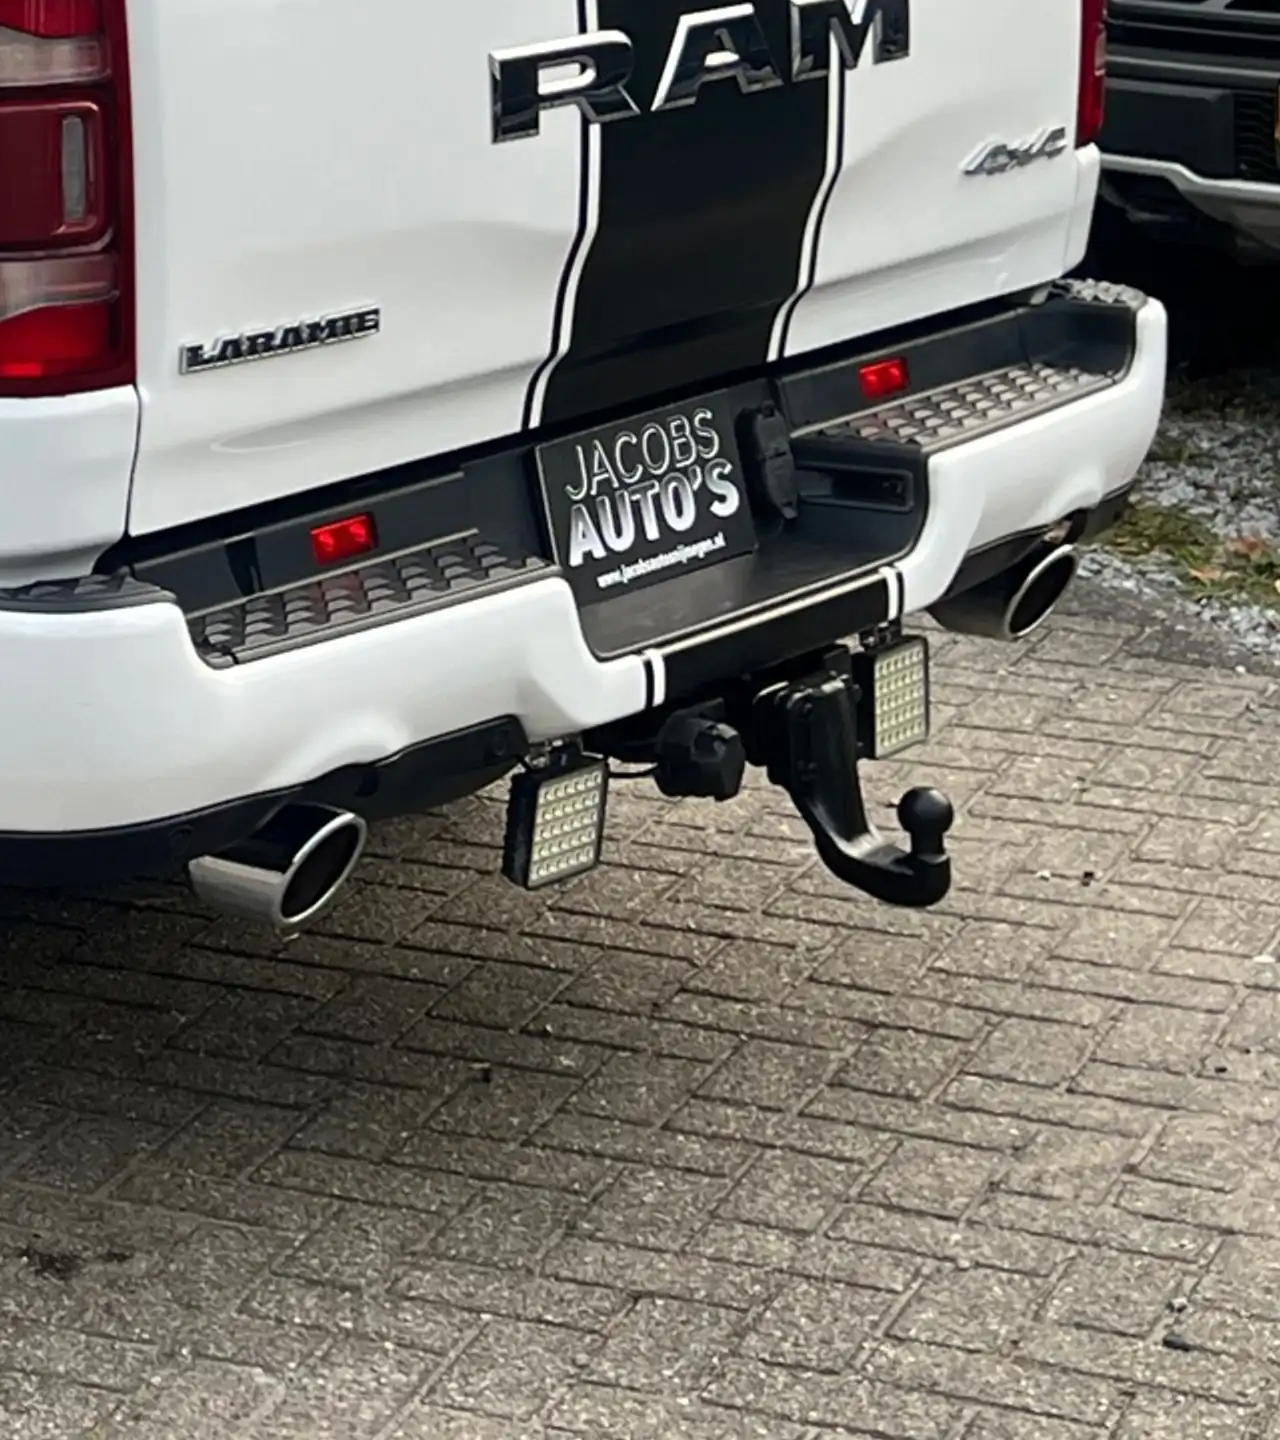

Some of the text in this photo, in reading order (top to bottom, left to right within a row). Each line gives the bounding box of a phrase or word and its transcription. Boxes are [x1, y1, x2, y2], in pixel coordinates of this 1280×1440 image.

[178, 302, 382, 376] LARAMIE
[564, 407, 720, 501] JACOBS
[568, 457, 740, 568] AUTO'S
